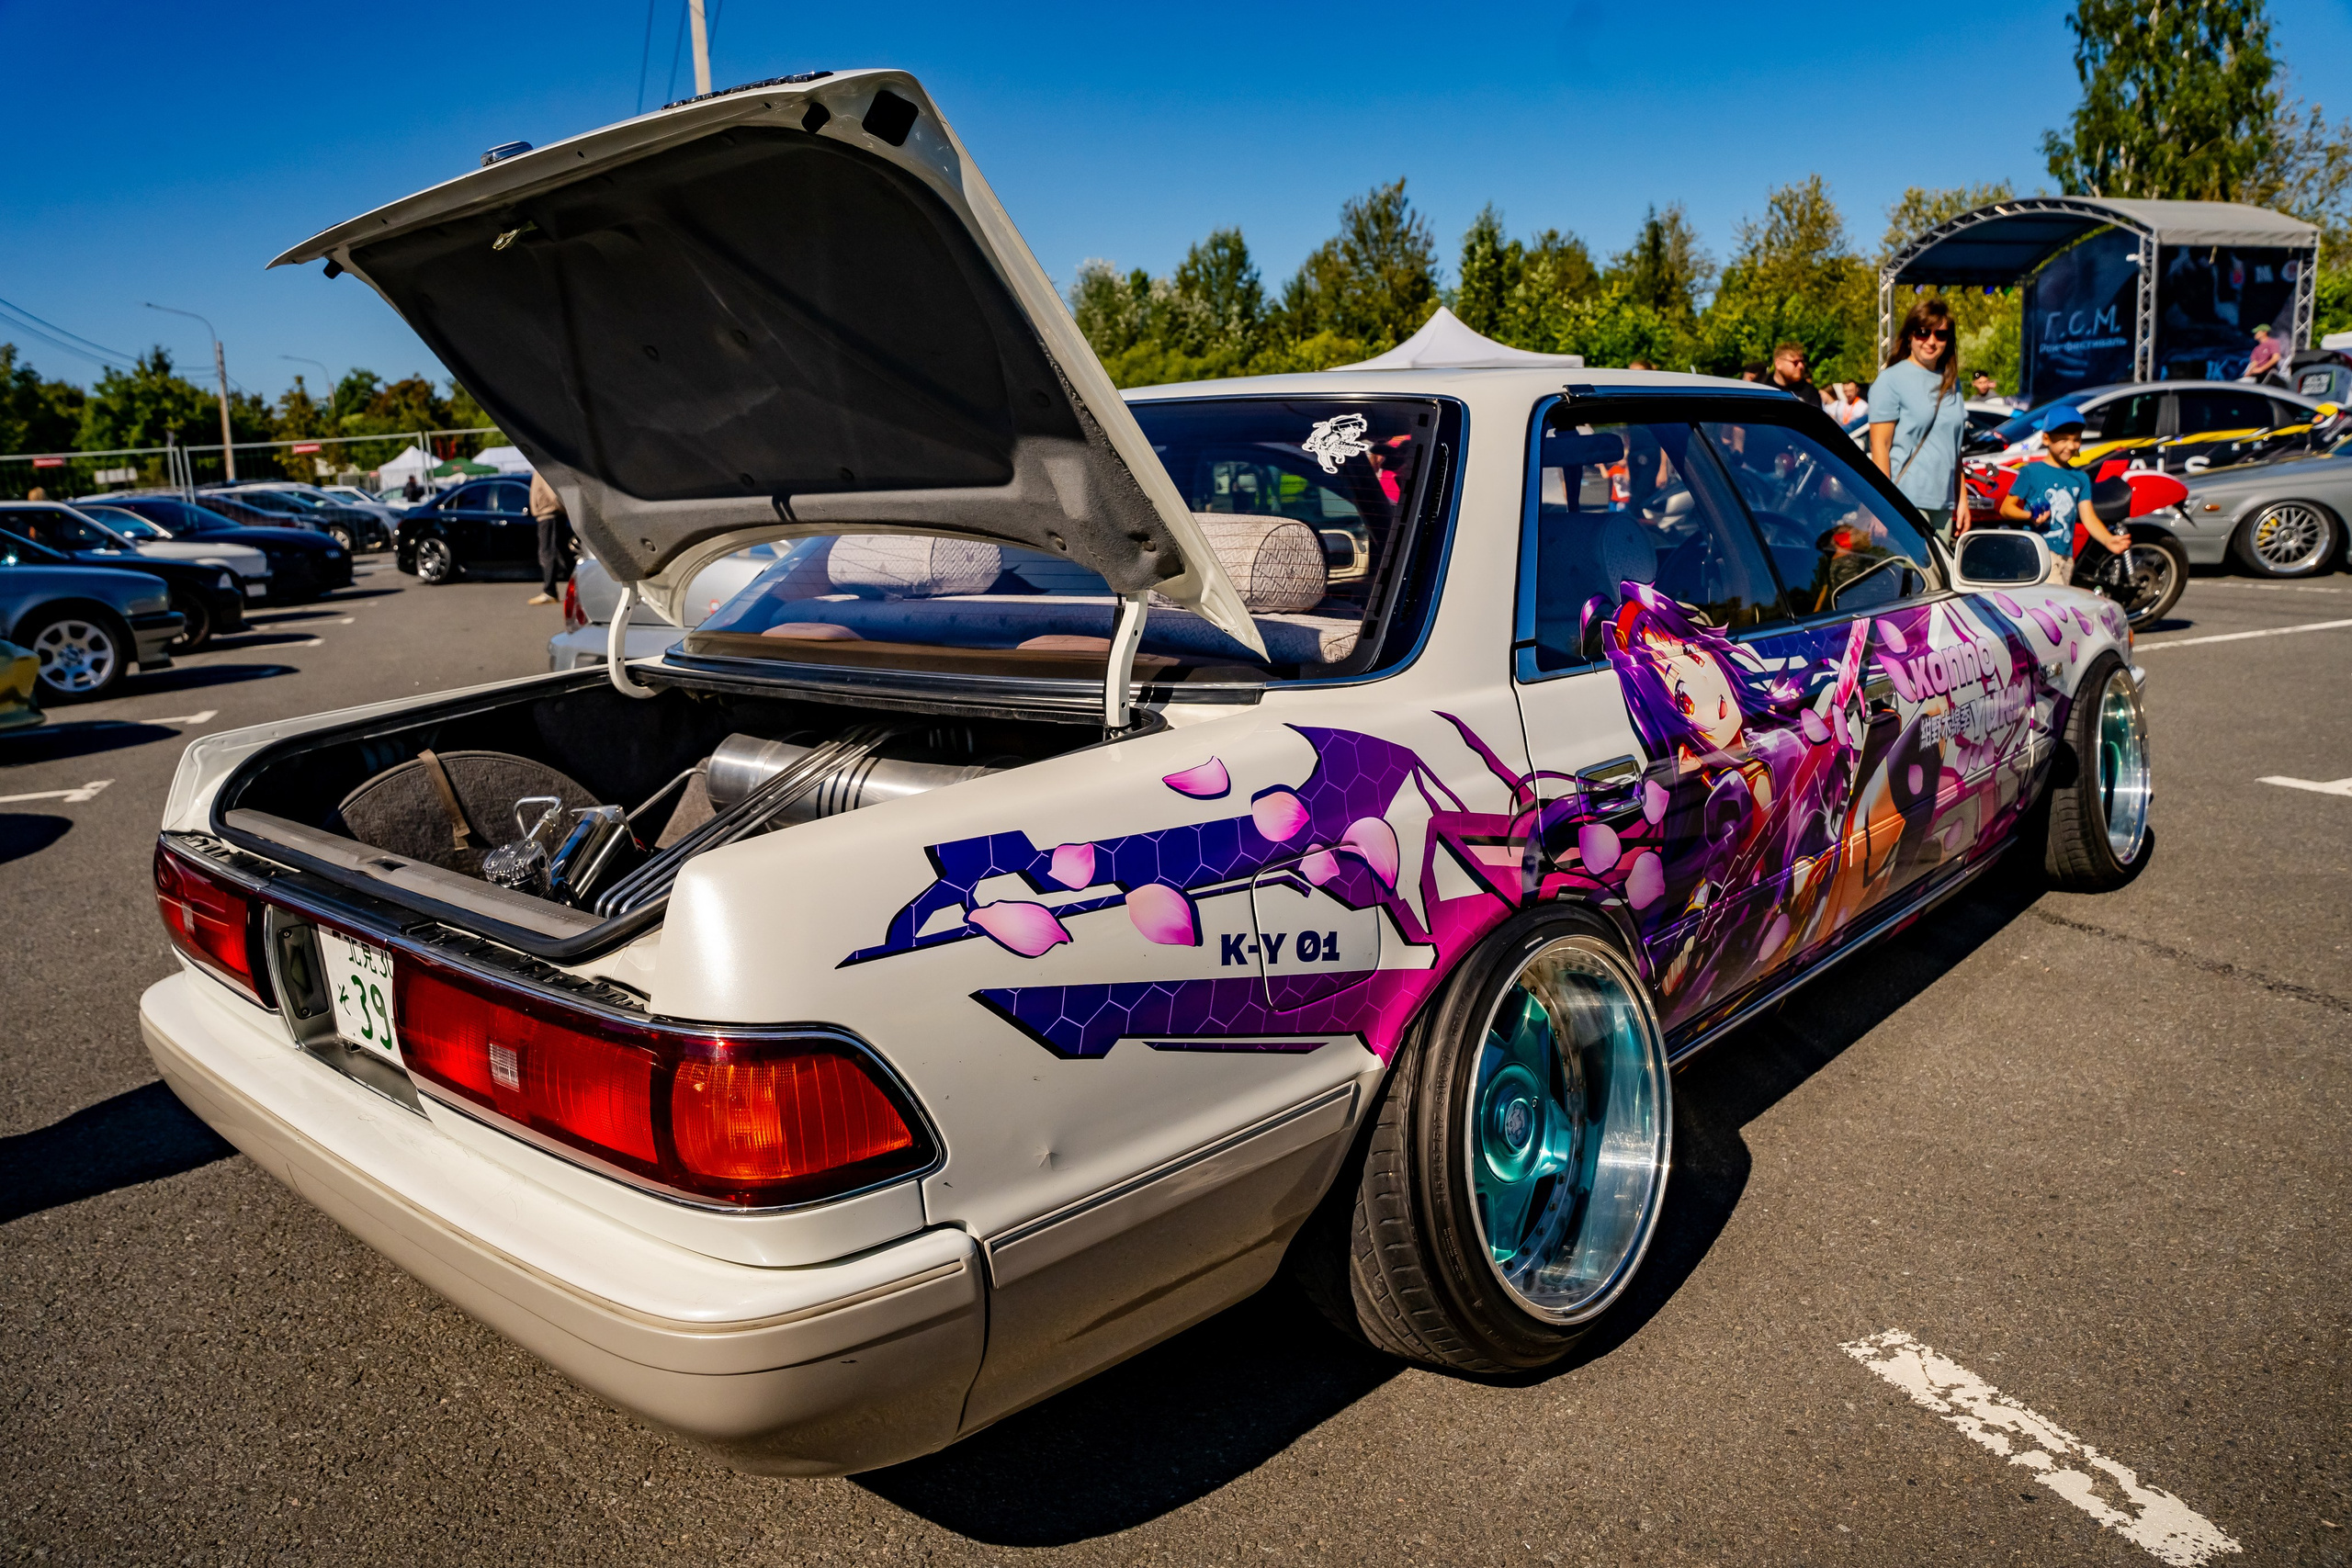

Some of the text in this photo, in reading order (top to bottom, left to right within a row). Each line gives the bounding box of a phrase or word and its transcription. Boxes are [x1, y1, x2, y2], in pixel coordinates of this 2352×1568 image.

[2043, 302, 2122, 342] Г.С.М.
[1221, 930, 1340, 966] K-Y 01
